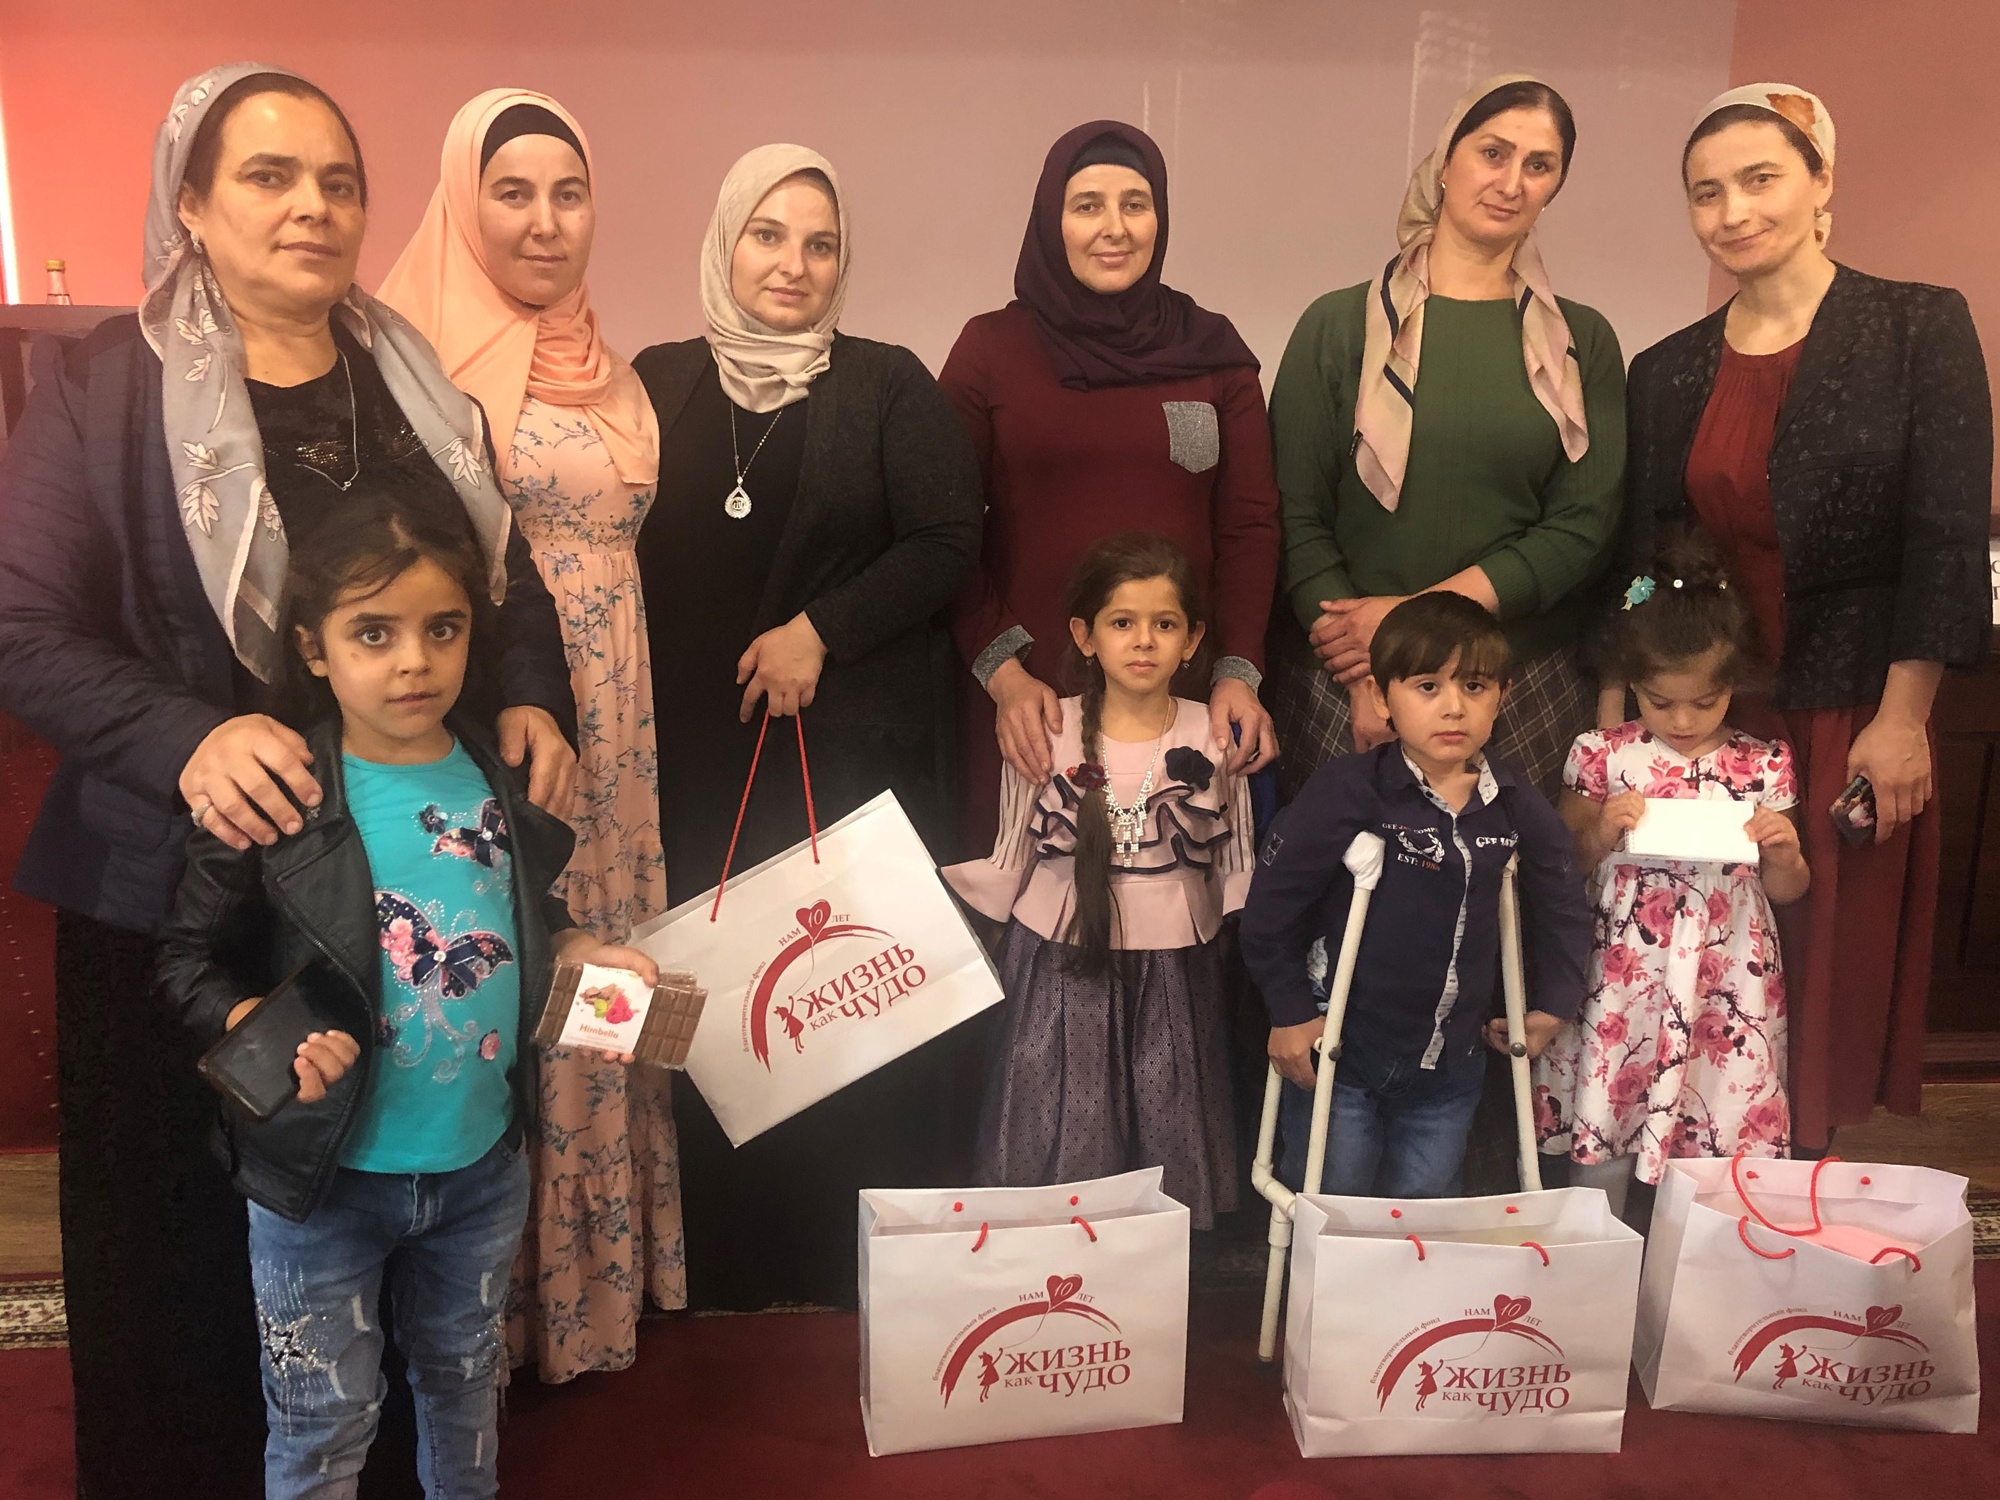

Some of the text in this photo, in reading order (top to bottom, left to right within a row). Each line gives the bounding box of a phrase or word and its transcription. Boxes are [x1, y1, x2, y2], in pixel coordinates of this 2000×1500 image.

[778, 909, 850, 947] НАМ 10 ЛЕТ
[797, 943, 915, 1019] ЖИЗНЬ
[838, 965, 927, 1020] ЧУДО
[1018, 1282, 1095, 1304] НАМ 10 ЛЕТ
[1464, 1303, 1542, 1327] НАМ 10 ЛЕТ
[1833, 1310, 1862, 1322] НАМ
[1873, 1312, 1893, 1324] 10
[1004, 1340, 1131, 1376] ЖИЗНЬ
[1804, 1353, 1935, 1384] ЖИЗНЬ
[1037, 1364, 1131, 1398] ЧУДО
[1443, 1363, 1571, 1389] ЖИЗНЬ
[1476, 1386, 1570, 1416] ЧУДО
[1839, 1380, 1931, 1406] ЧУДО
